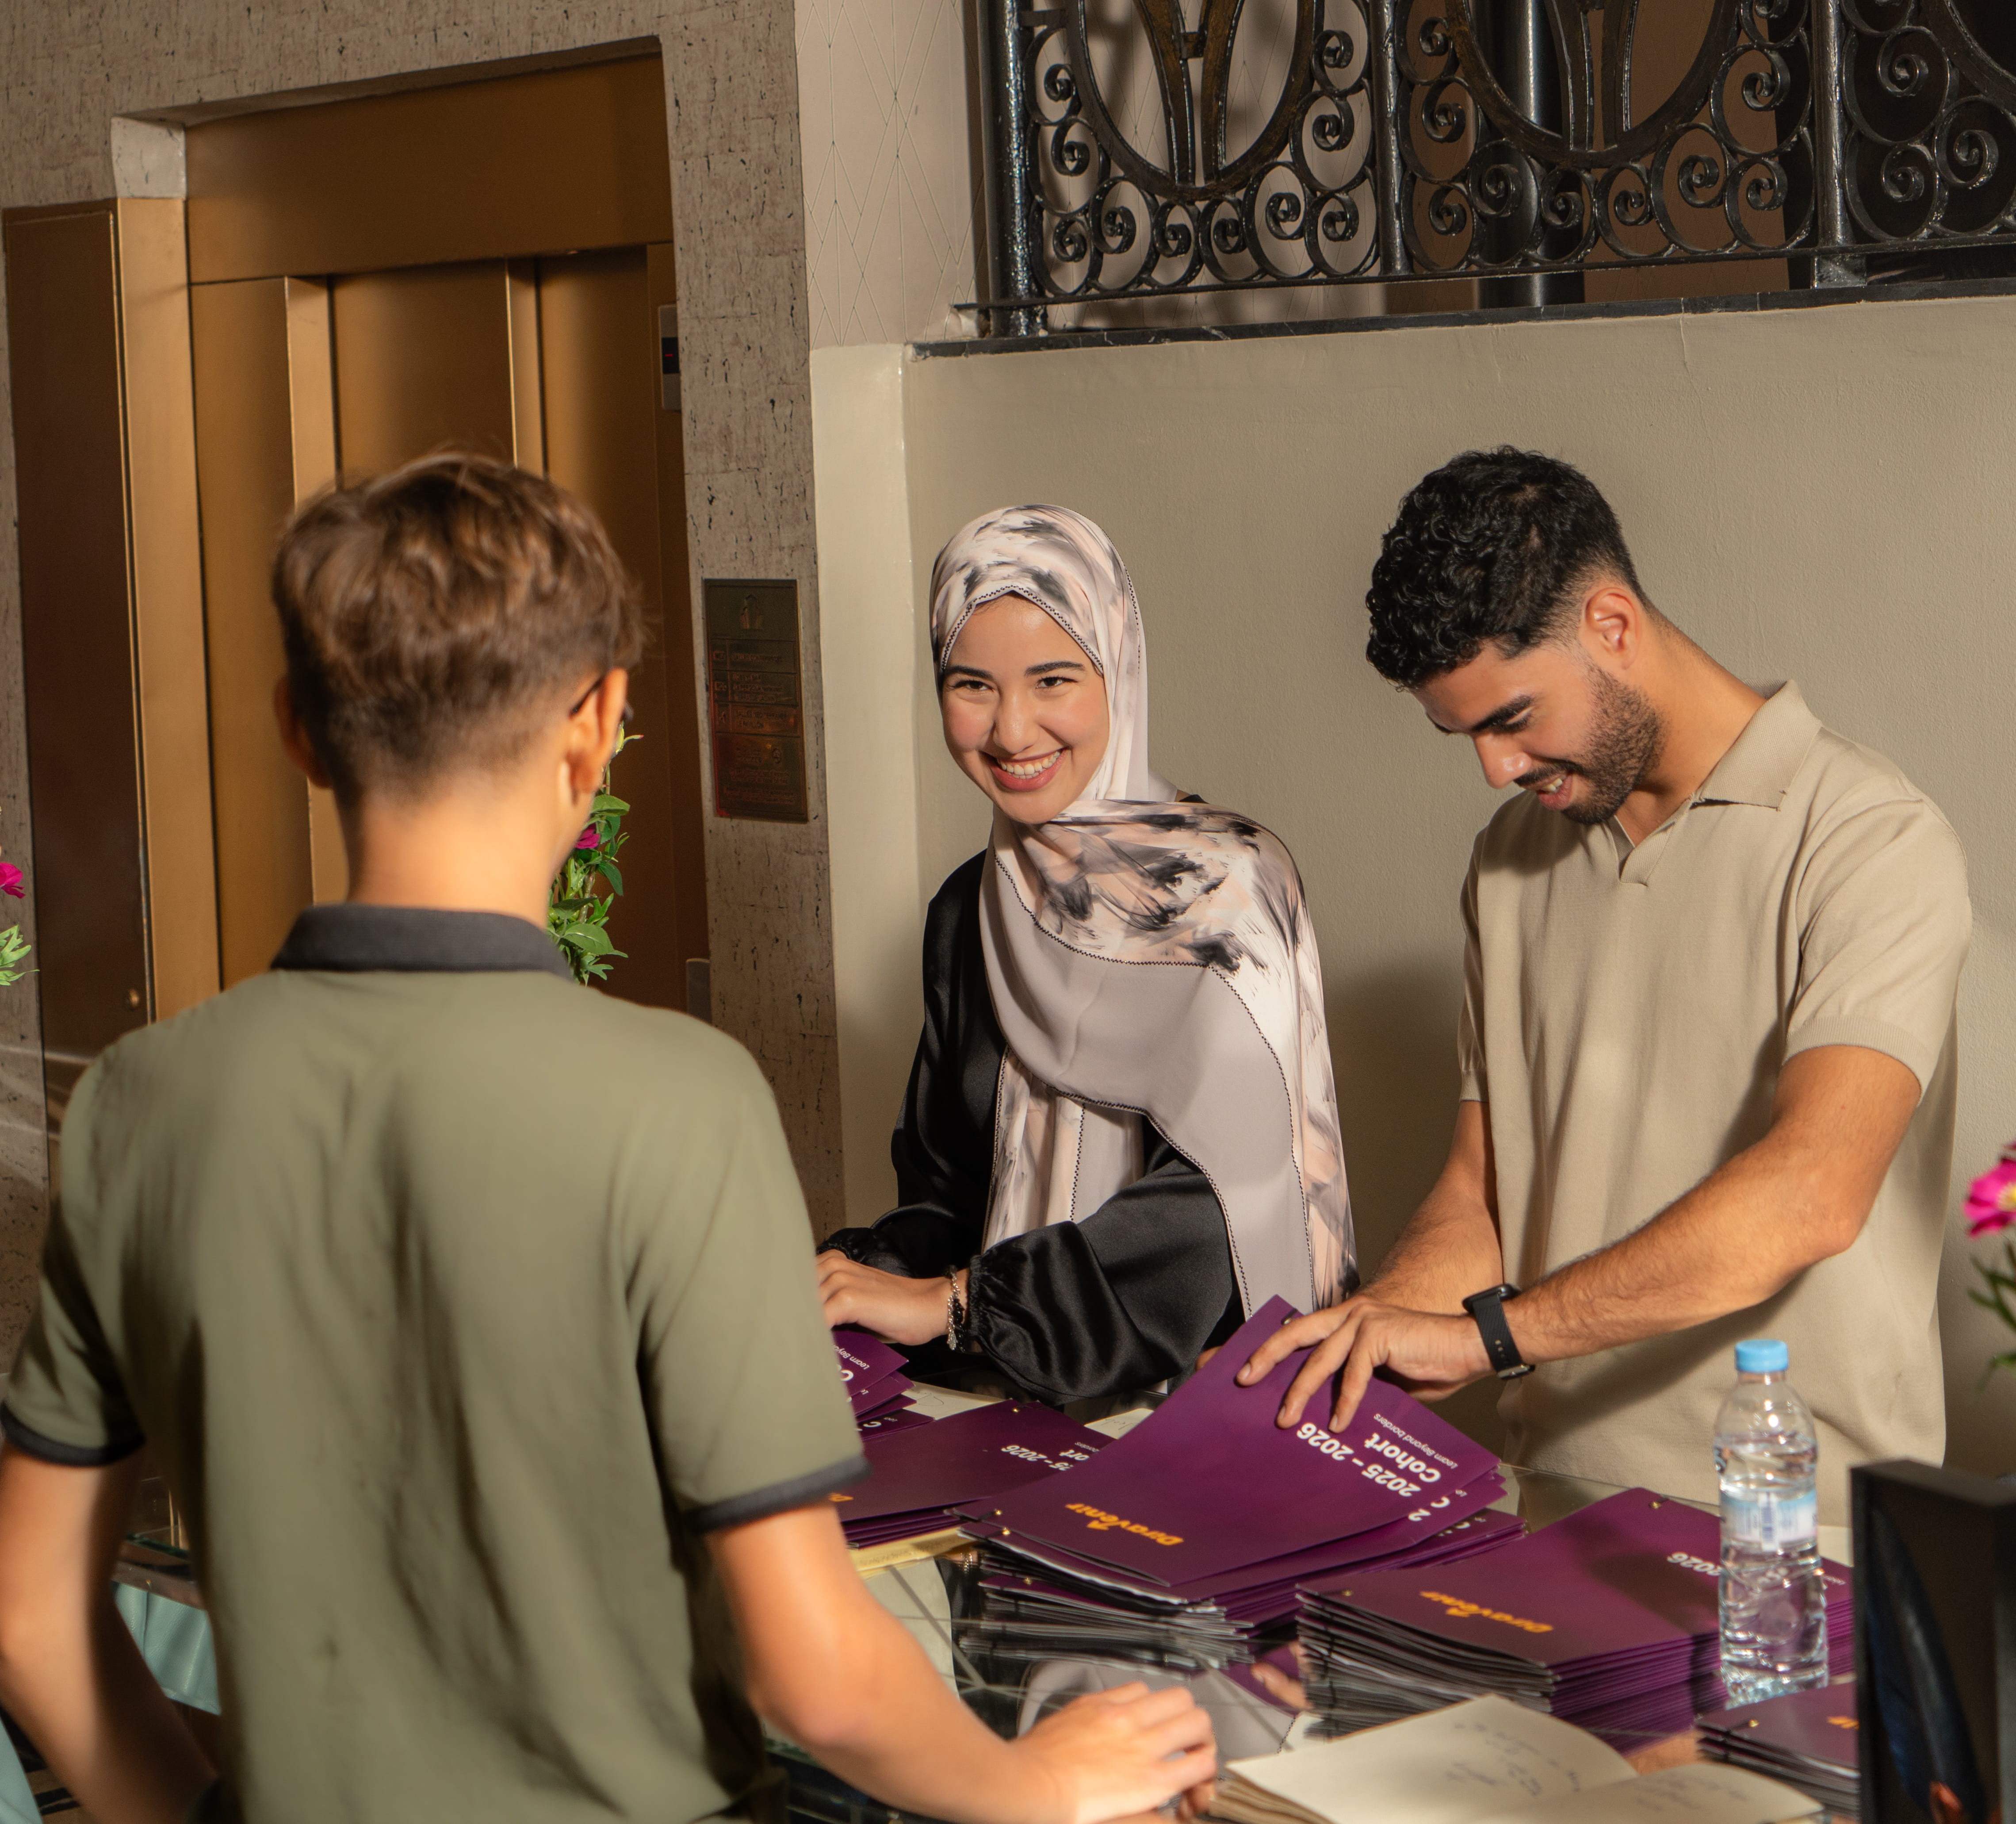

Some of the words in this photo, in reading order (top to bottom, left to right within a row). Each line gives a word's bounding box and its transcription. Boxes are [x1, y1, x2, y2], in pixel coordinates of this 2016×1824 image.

[831, 1345, 851, 1359] Beyo
[849, 1357, 870, 1370] Learn
[1373, 1413, 1406, 1438] borders
[1297, 1422, 1354, 1460] 2026
[1403, 1434, 1435, 1456] Beyond
[1001, 1445, 1048, 1461] 2026
[1059, 1449, 1090, 1461] ort
[1364, 1433, 1441, 1483] Cohort
[1434, 1453, 1458, 1469] Learn
[1361, 1464, 1421, 1497] 2025
[1667, 1552, 1723, 1576] 2026
